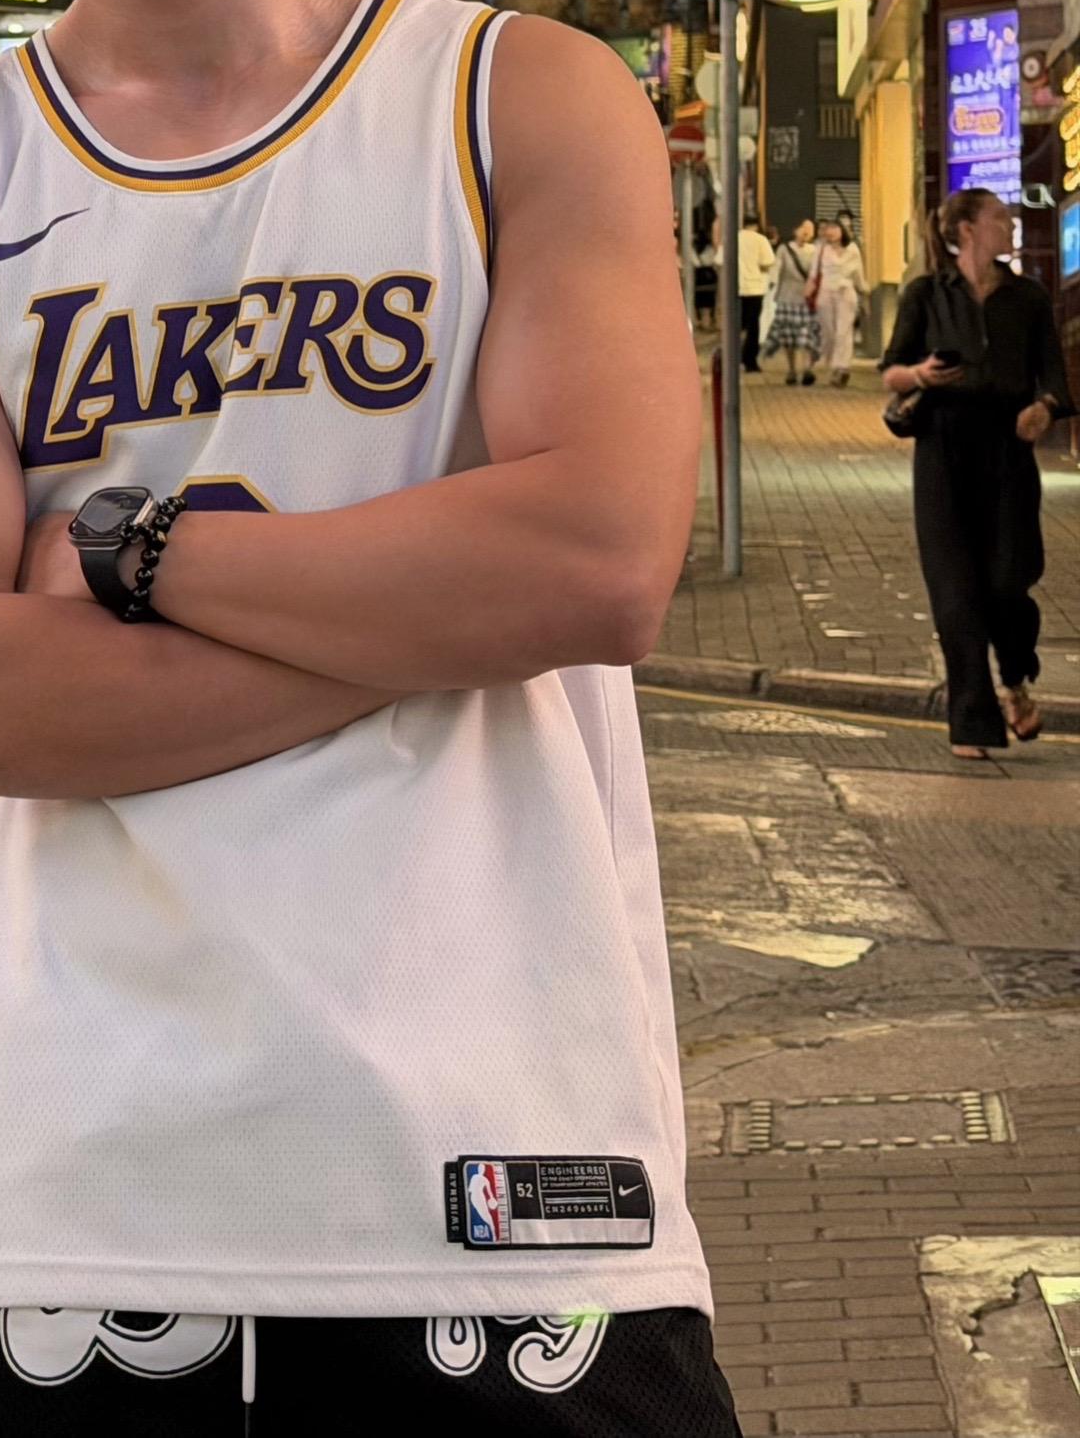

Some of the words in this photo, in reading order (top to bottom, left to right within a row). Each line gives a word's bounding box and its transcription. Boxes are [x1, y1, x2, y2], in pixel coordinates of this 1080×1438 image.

[20, 270, 438, 474] LAKERS
[540, 1165, 607, 1176] ENGINEERED
[515, 1182, 534, 1199] 52
[451, 1172, 459, 1232] SWINGMAN
[473, 1224, 490, 1240] NBA
